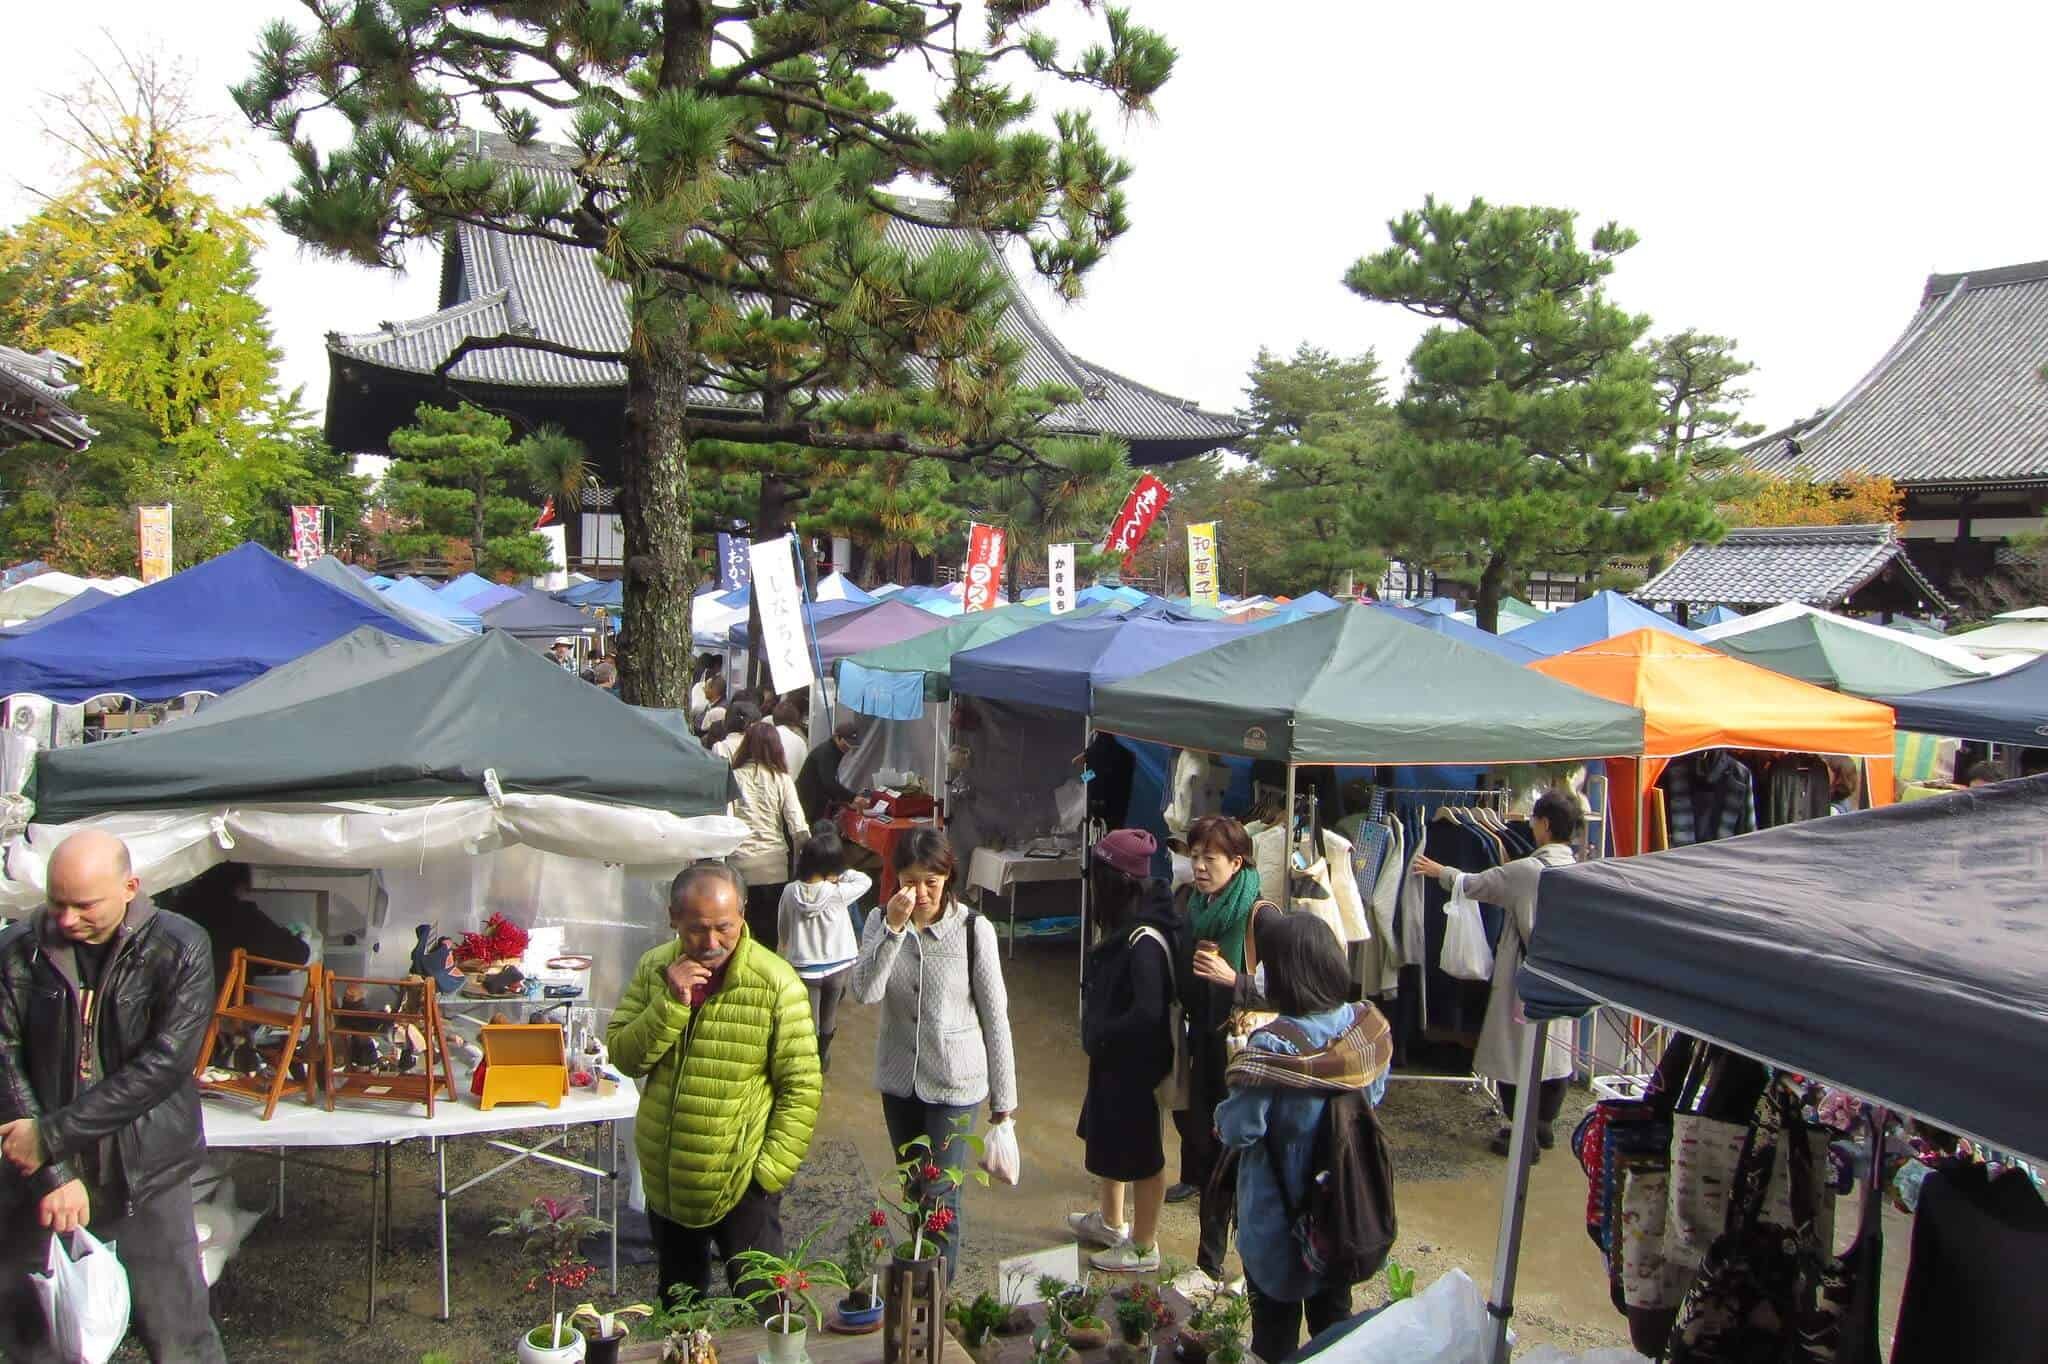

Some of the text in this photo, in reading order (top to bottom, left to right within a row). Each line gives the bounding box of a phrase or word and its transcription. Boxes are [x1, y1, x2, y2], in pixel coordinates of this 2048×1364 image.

[1055, 559, 1065, 611] かきもち
[1192, 535, 1213, 600] 和菓子
